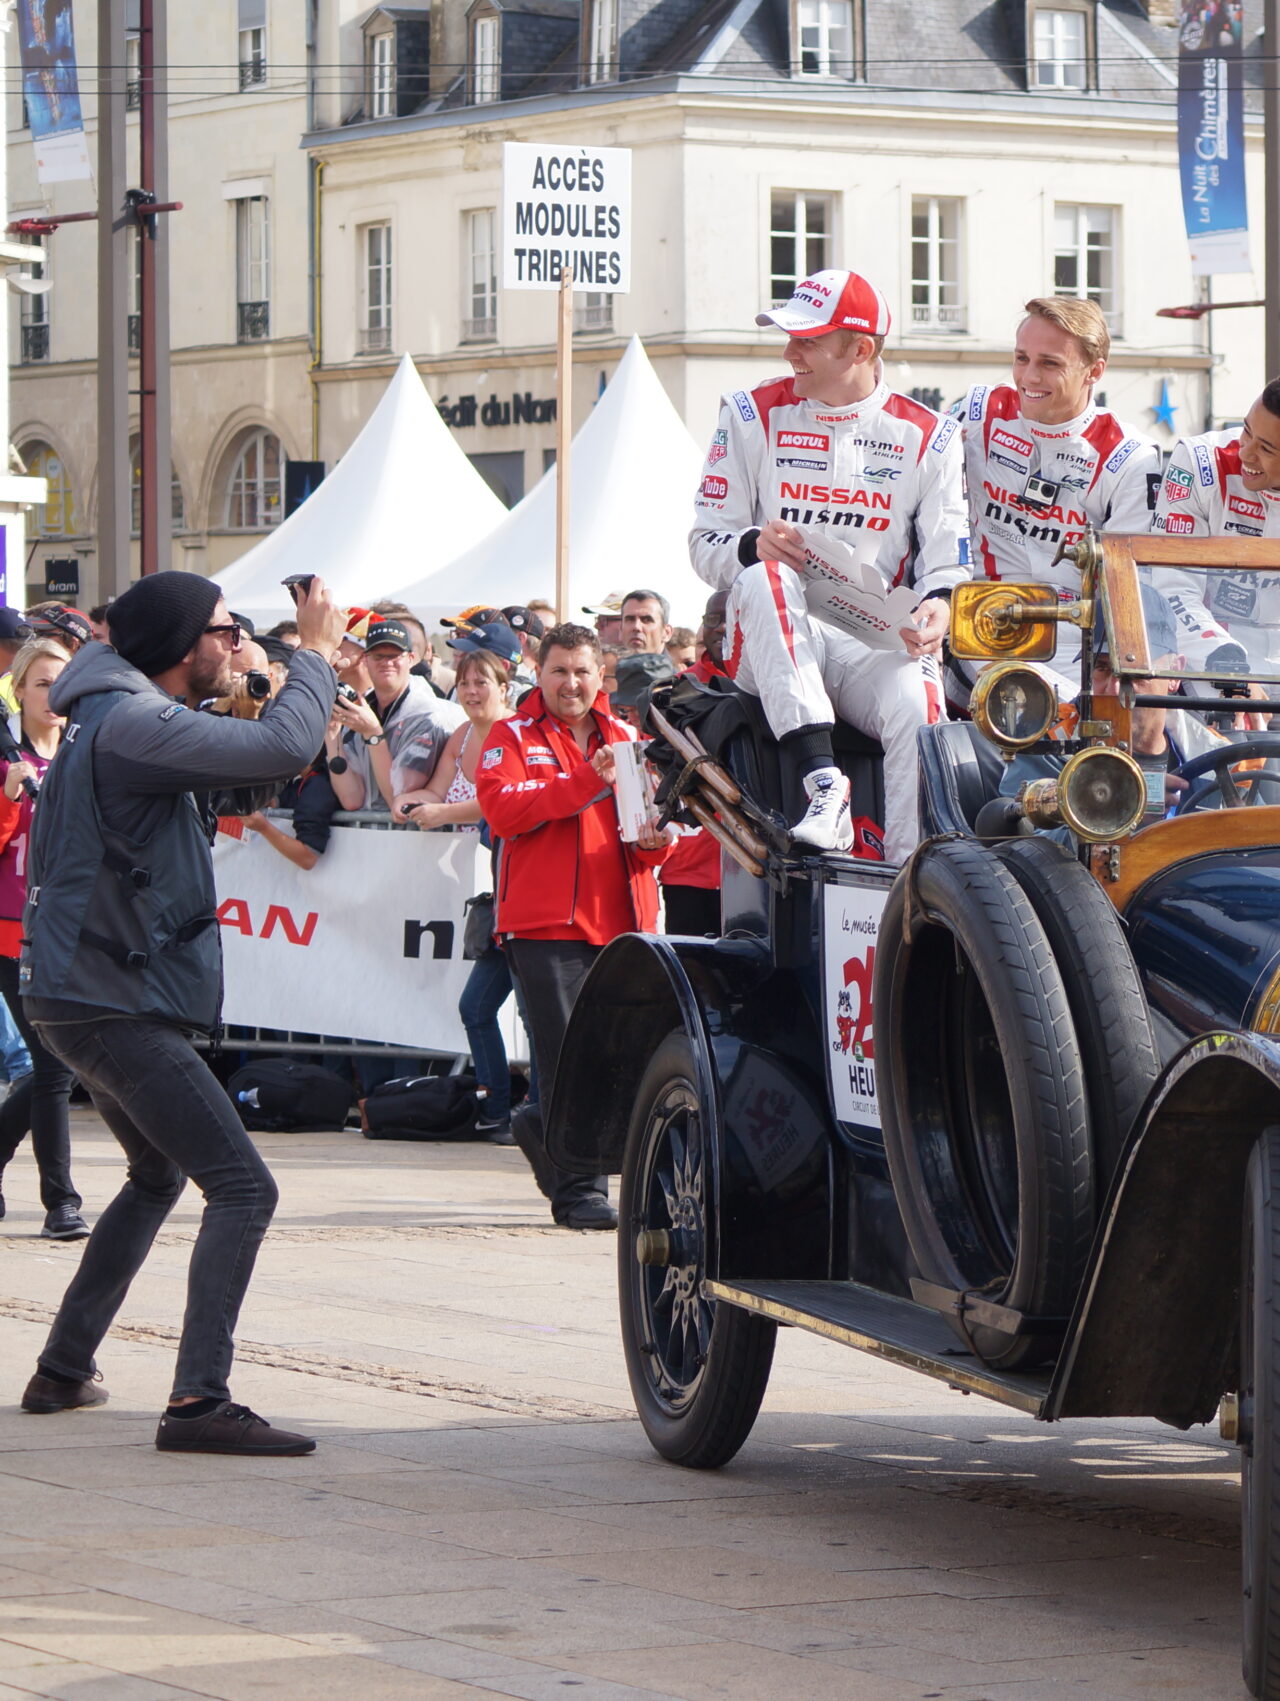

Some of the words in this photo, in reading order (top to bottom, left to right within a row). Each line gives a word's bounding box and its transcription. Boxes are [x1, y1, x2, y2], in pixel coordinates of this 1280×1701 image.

[532, 149, 604, 193] ACCÈS
[516, 202, 621, 239] MODULES
[514, 248, 621, 285] TRIBUNES
[843, 316, 870, 328] MOTUL
[436, 394, 478, 428] édit
[815, 412, 859, 422] NISSAN
[779, 434, 826, 448] MOTUL
[994, 431, 1030, 456] MOTUL
[1030, 428, 1071, 439] NISSAN
[853, 438, 905, 454] nismo
[791, 459, 827, 469] MICHELIN
[1056, 452, 1096, 469] nismo
[863, 465, 902, 481] WEC
[1167, 467, 1190, 486] TAG
[780, 481, 892, 510] NISSAN
[983, 480, 1088, 526] NISSAN
[780, 506, 891, 532] nismo
[831, 595, 892, 629] NISSAN
[851, 914, 877, 935] musée
